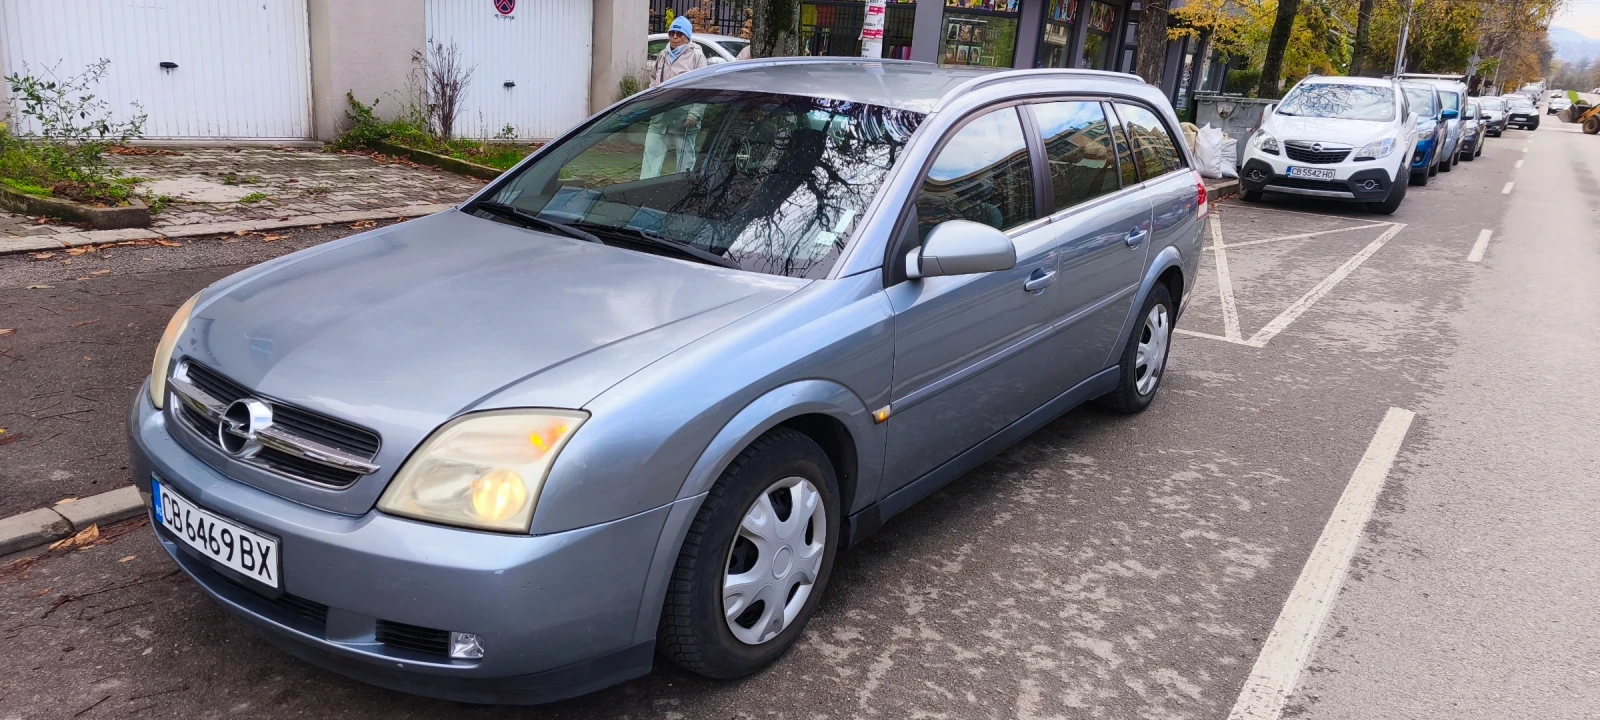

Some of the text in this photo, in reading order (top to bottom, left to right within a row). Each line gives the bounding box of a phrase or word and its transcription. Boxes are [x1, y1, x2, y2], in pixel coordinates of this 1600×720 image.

[1303, 169, 1321, 177] 5542
[162, 491, 273, 581] CB 6469 BX
